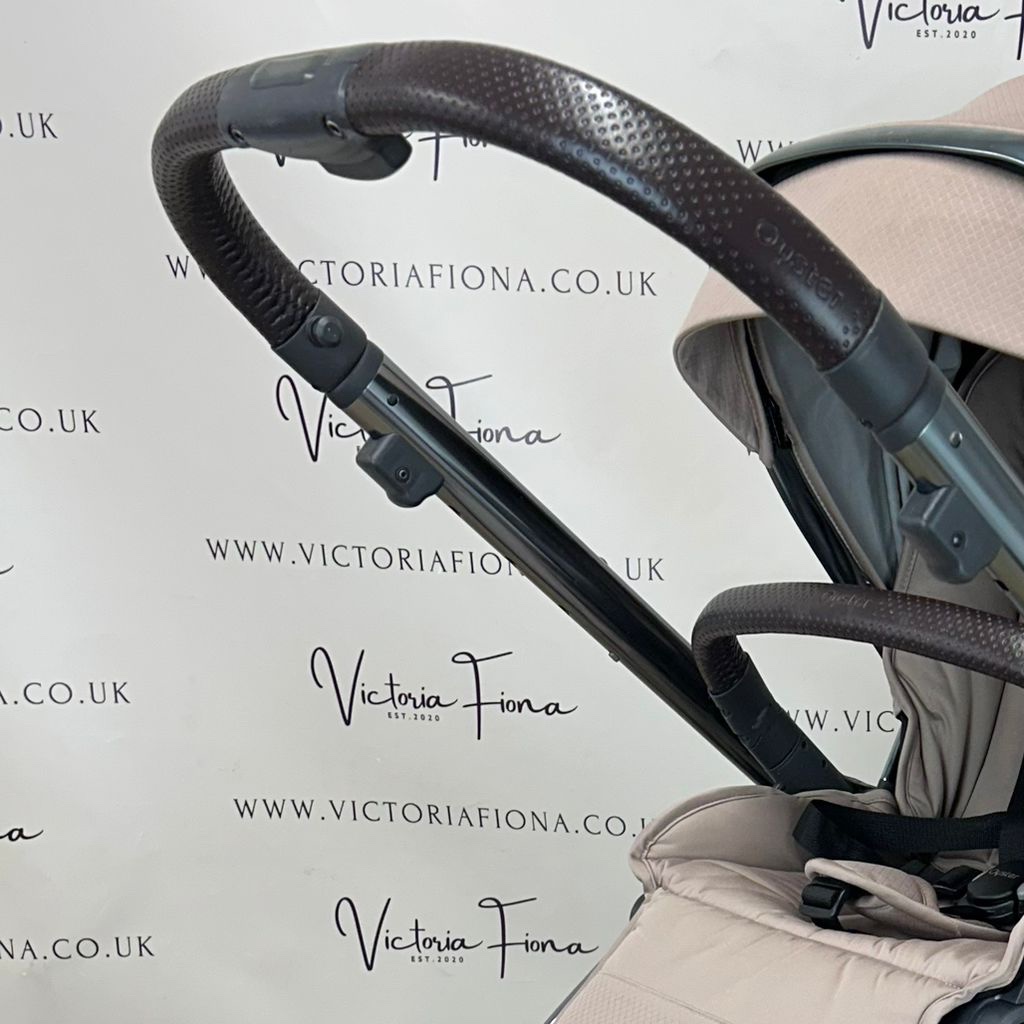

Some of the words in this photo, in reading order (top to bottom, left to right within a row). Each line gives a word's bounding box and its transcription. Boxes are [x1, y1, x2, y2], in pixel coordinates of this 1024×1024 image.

[916, 29, 976, 39] EST.2020
[0, 112, 58, 139] .UK
[165, 254, 657, 297] WCTORIAFIONA.CO.UK
[755, 218, 845, 309] Oyster
[206, 538, 665, 581] WWW.VICTORIAFIOUK
[310, 646, 458, 726] Victoria
[452, 652, 578, 740] Fiona
[388, 712, 440, 721] EST.2020
[233, 798, 654, 837] WWW.VICTORIAFIONA.CO.
[335, 897, 484, 971] Victoria
[478, 897, 599, 979] Fiona
[411, 955, 463, 963] EST.2020
